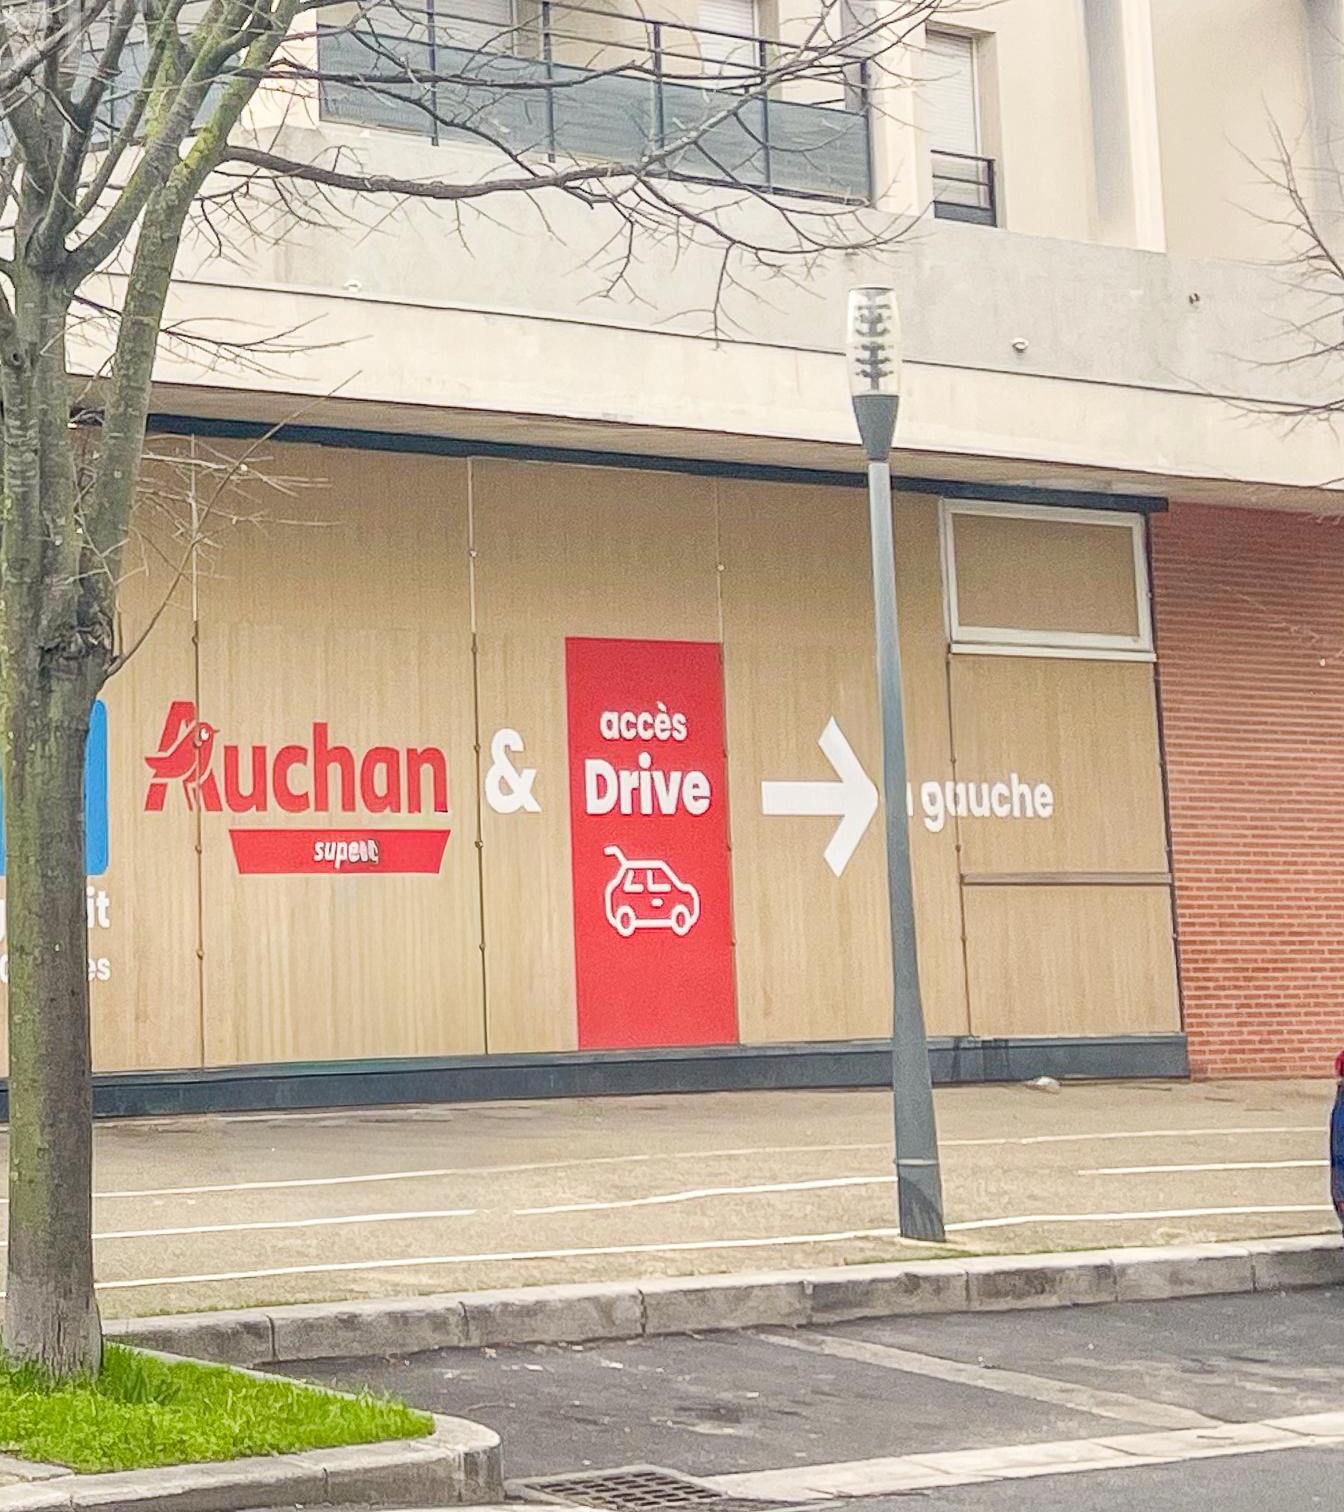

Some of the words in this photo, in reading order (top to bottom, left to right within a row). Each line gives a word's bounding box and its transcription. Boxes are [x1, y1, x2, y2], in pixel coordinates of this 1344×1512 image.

[600, 701, 688, 741] accès
[144, 701, 450, 814] Auchan
[484, 728, 543, 814] &
[584, 751, 712, 816] Drive
[920, 772, 1054, 833] gauche
